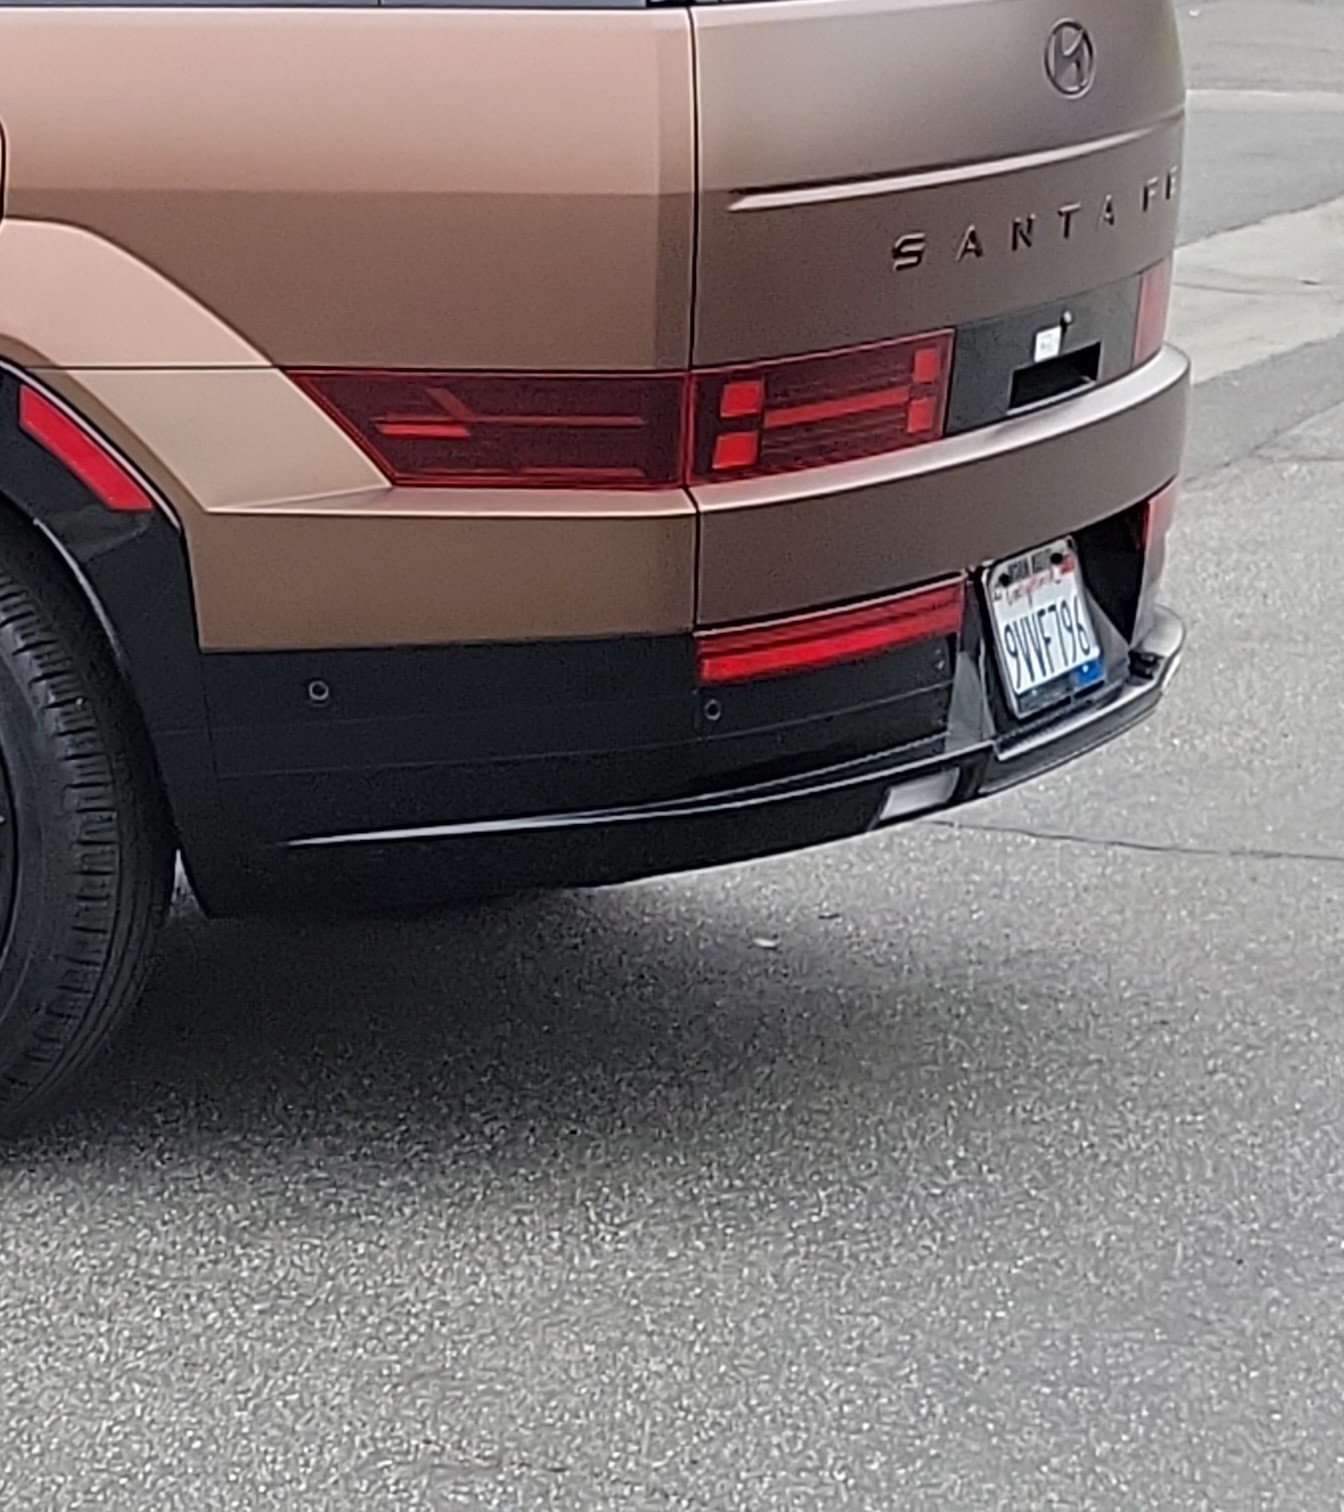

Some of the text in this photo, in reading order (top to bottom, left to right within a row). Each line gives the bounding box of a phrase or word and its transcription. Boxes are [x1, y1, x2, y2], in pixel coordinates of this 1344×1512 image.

[892, 164, 1179, 272] SANTA FE
[1003, 595, 1091, 690] 9VVF796
